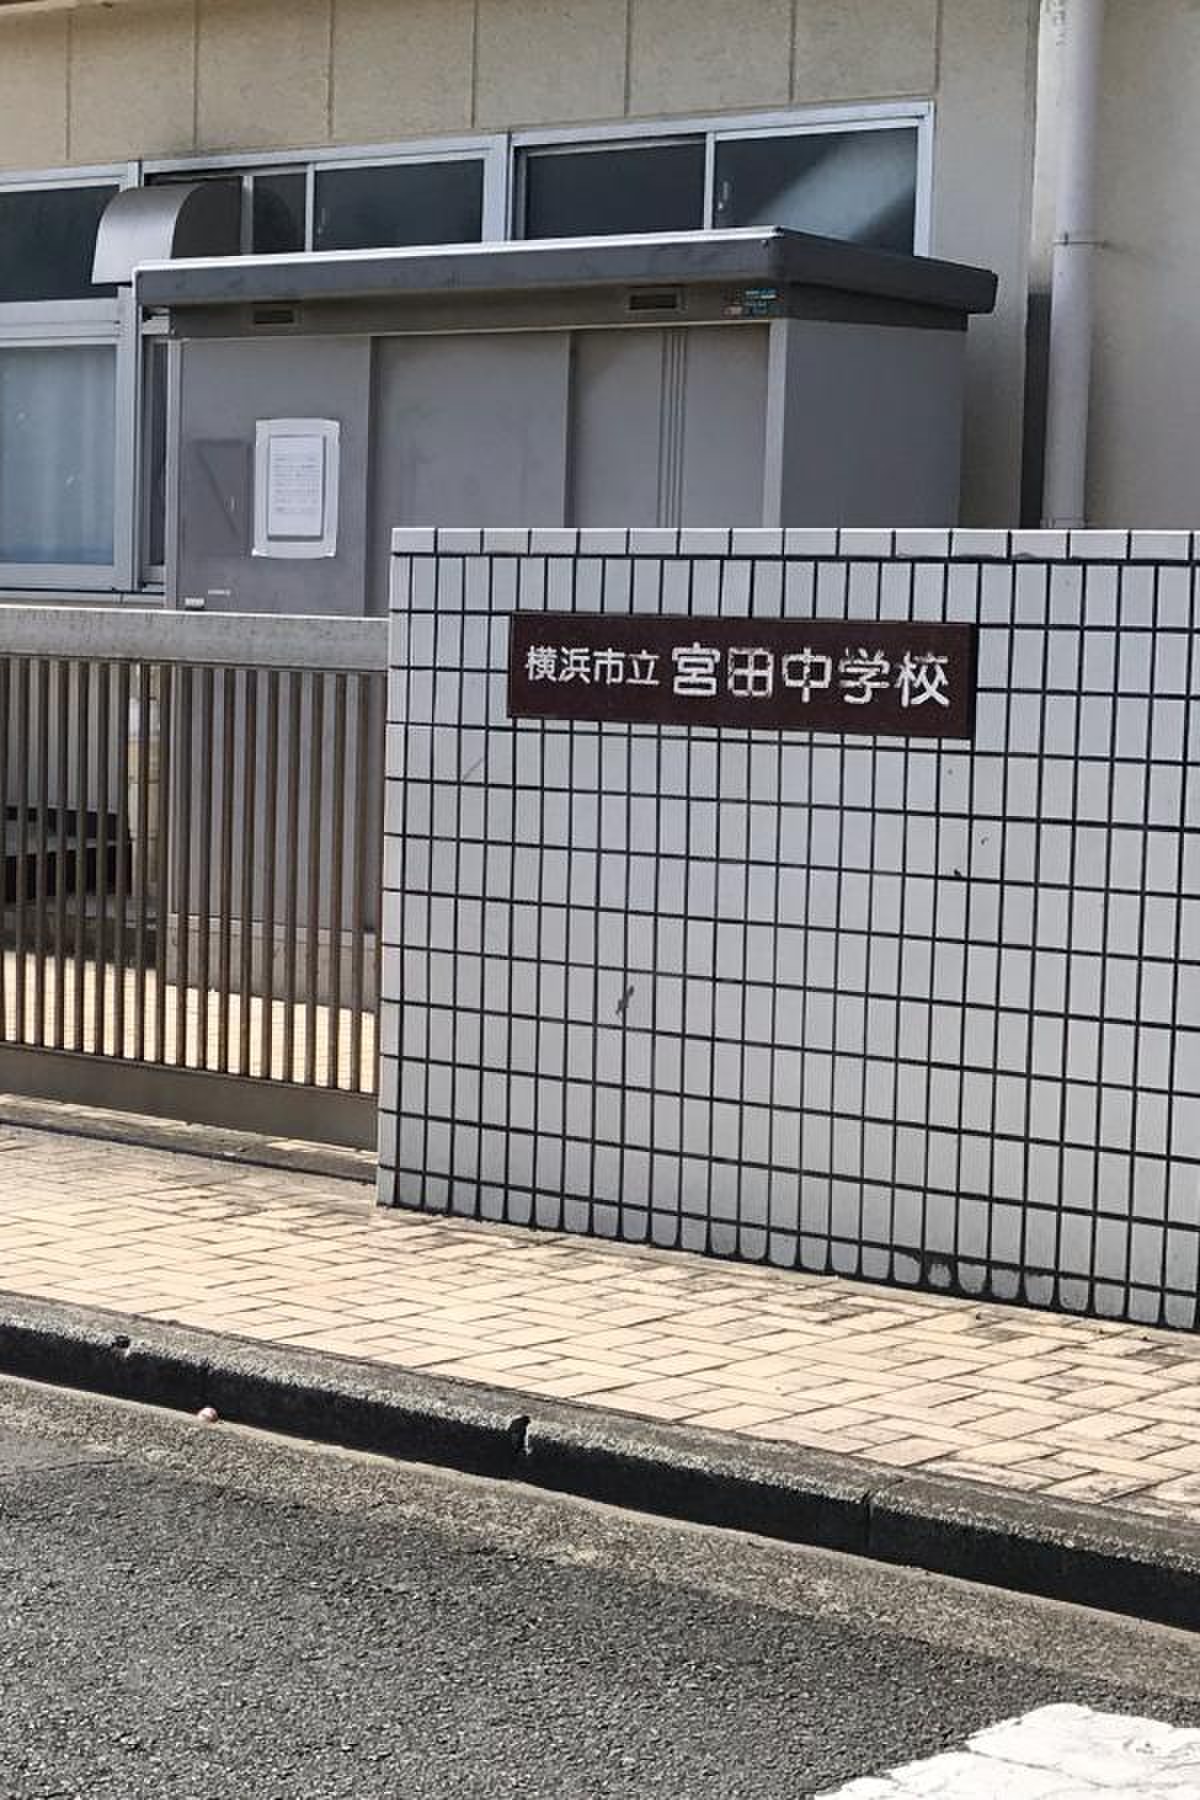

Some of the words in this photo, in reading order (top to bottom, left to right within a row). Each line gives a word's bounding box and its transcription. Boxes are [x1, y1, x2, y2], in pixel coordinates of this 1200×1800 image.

[524, 645, 660, 687] 横浜市立
[672, 642, 950, 707] 宮田中学校
